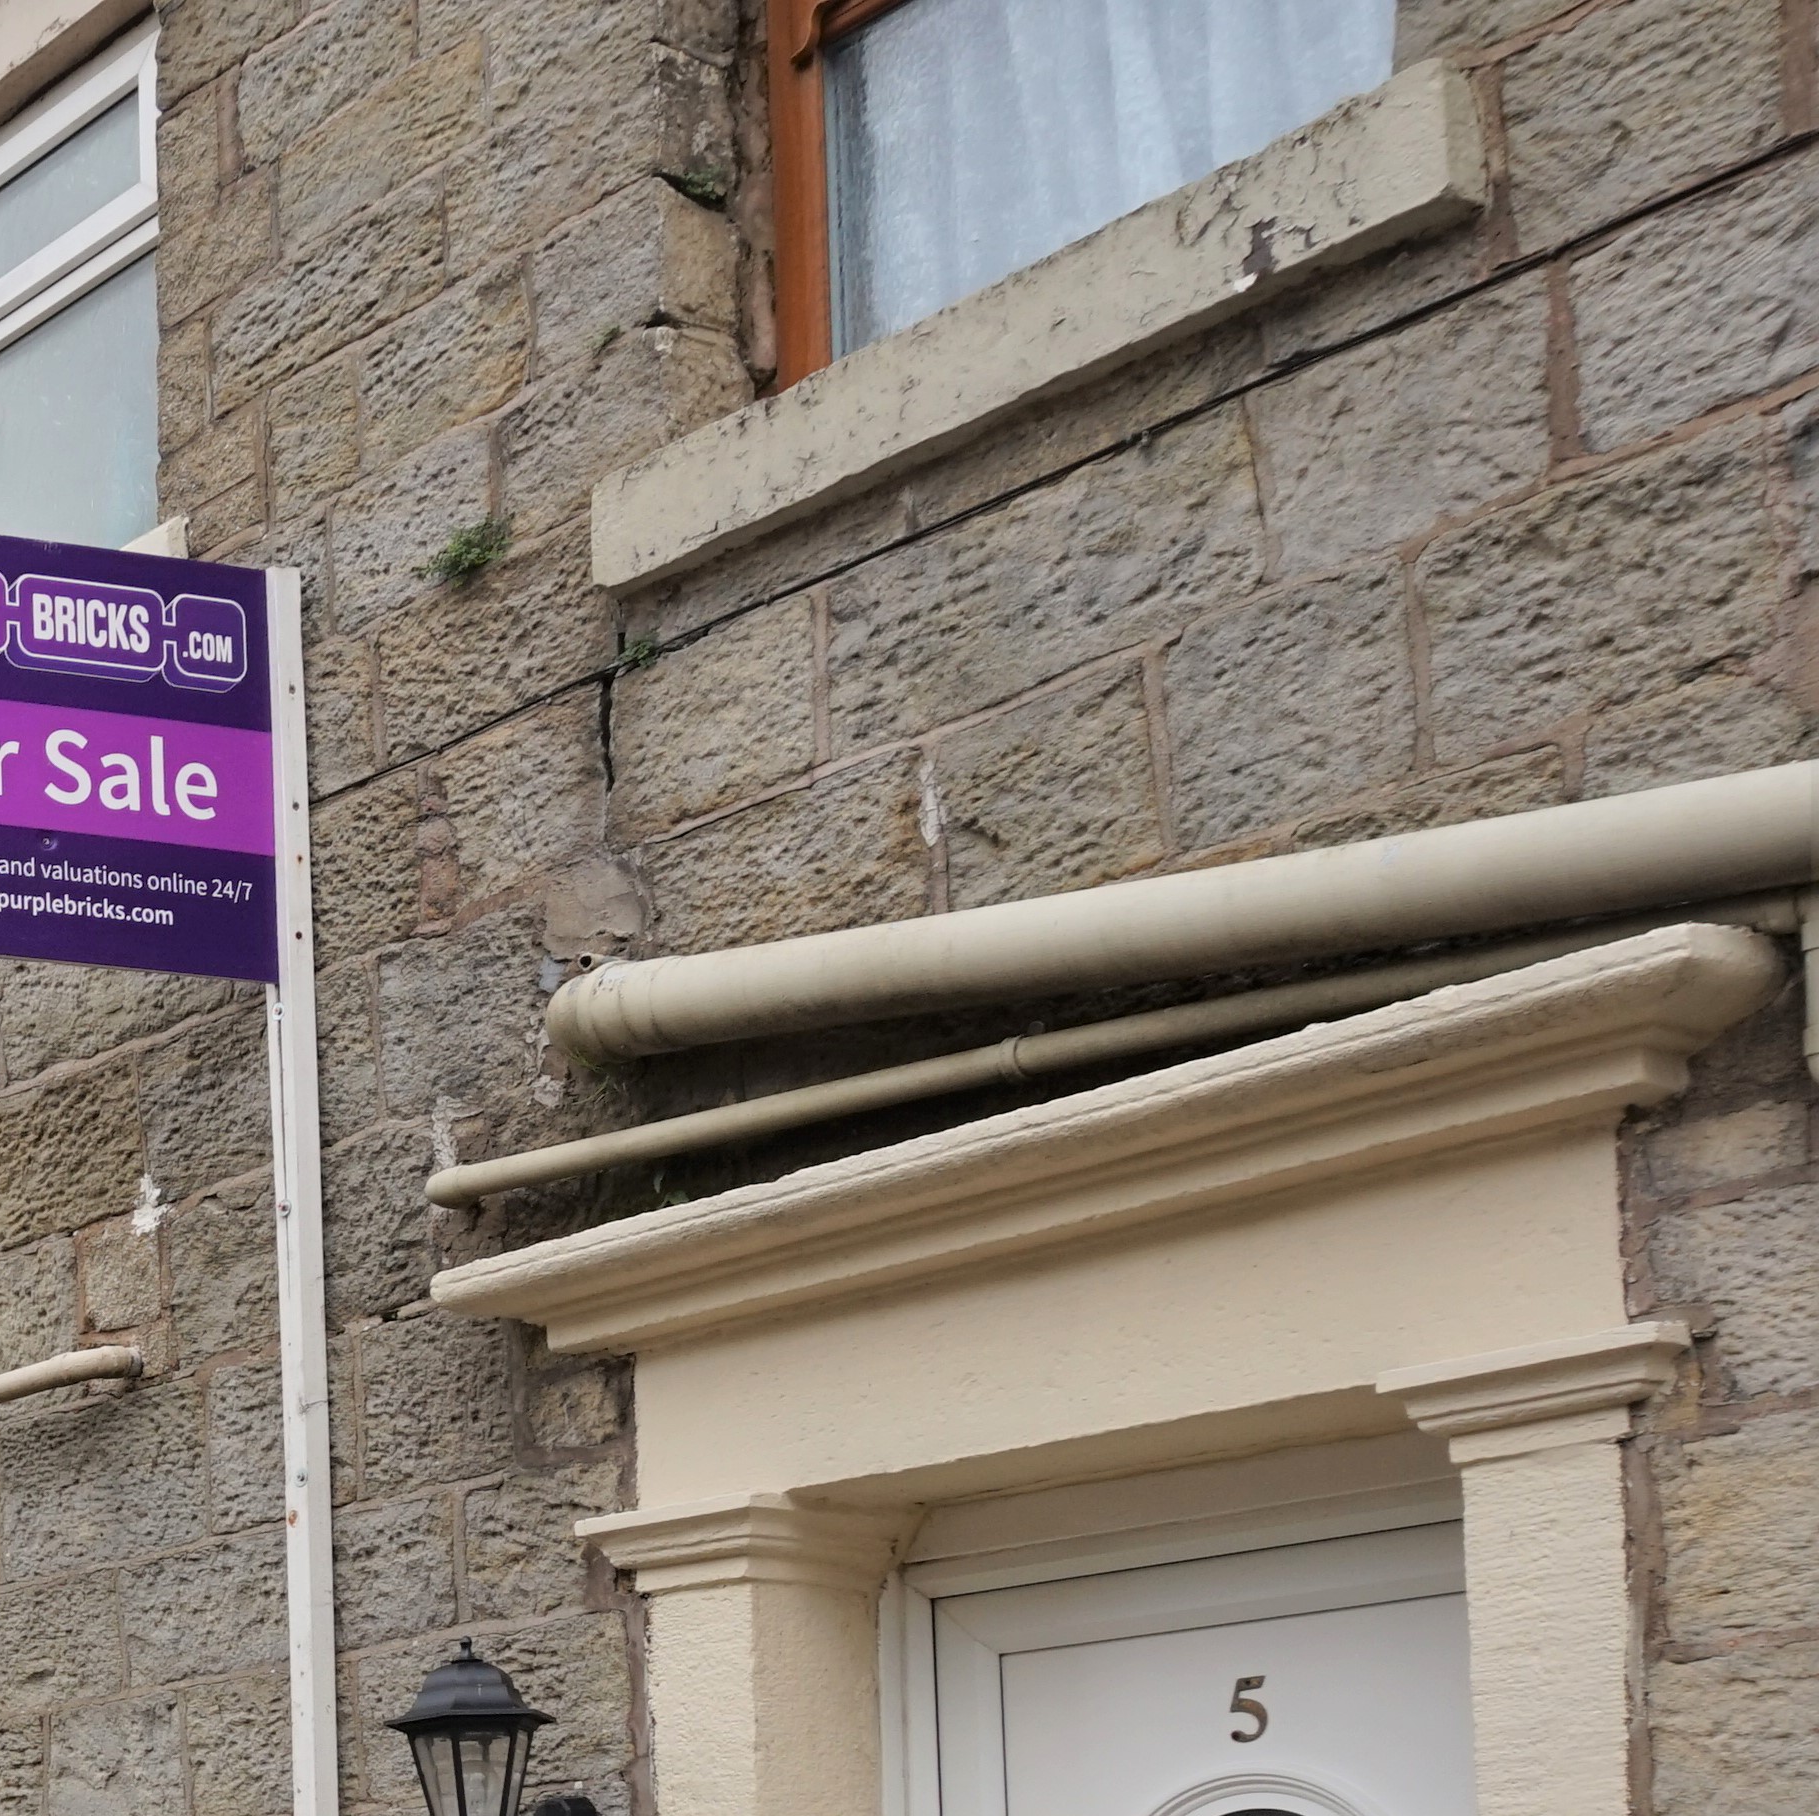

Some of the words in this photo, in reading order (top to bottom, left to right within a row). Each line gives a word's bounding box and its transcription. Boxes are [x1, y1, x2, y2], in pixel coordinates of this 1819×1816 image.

[32, 592, 151, 654] BRICKS
[182, 629, 233, 664] .COM
[44, 728, 218, 821] Sale
[40, 860, 143, 890] valuations
[147, 872, 208, 897] online
[211, 878, 253, 903] 24/7
[1229, 1675, 1268, 1743] 5
